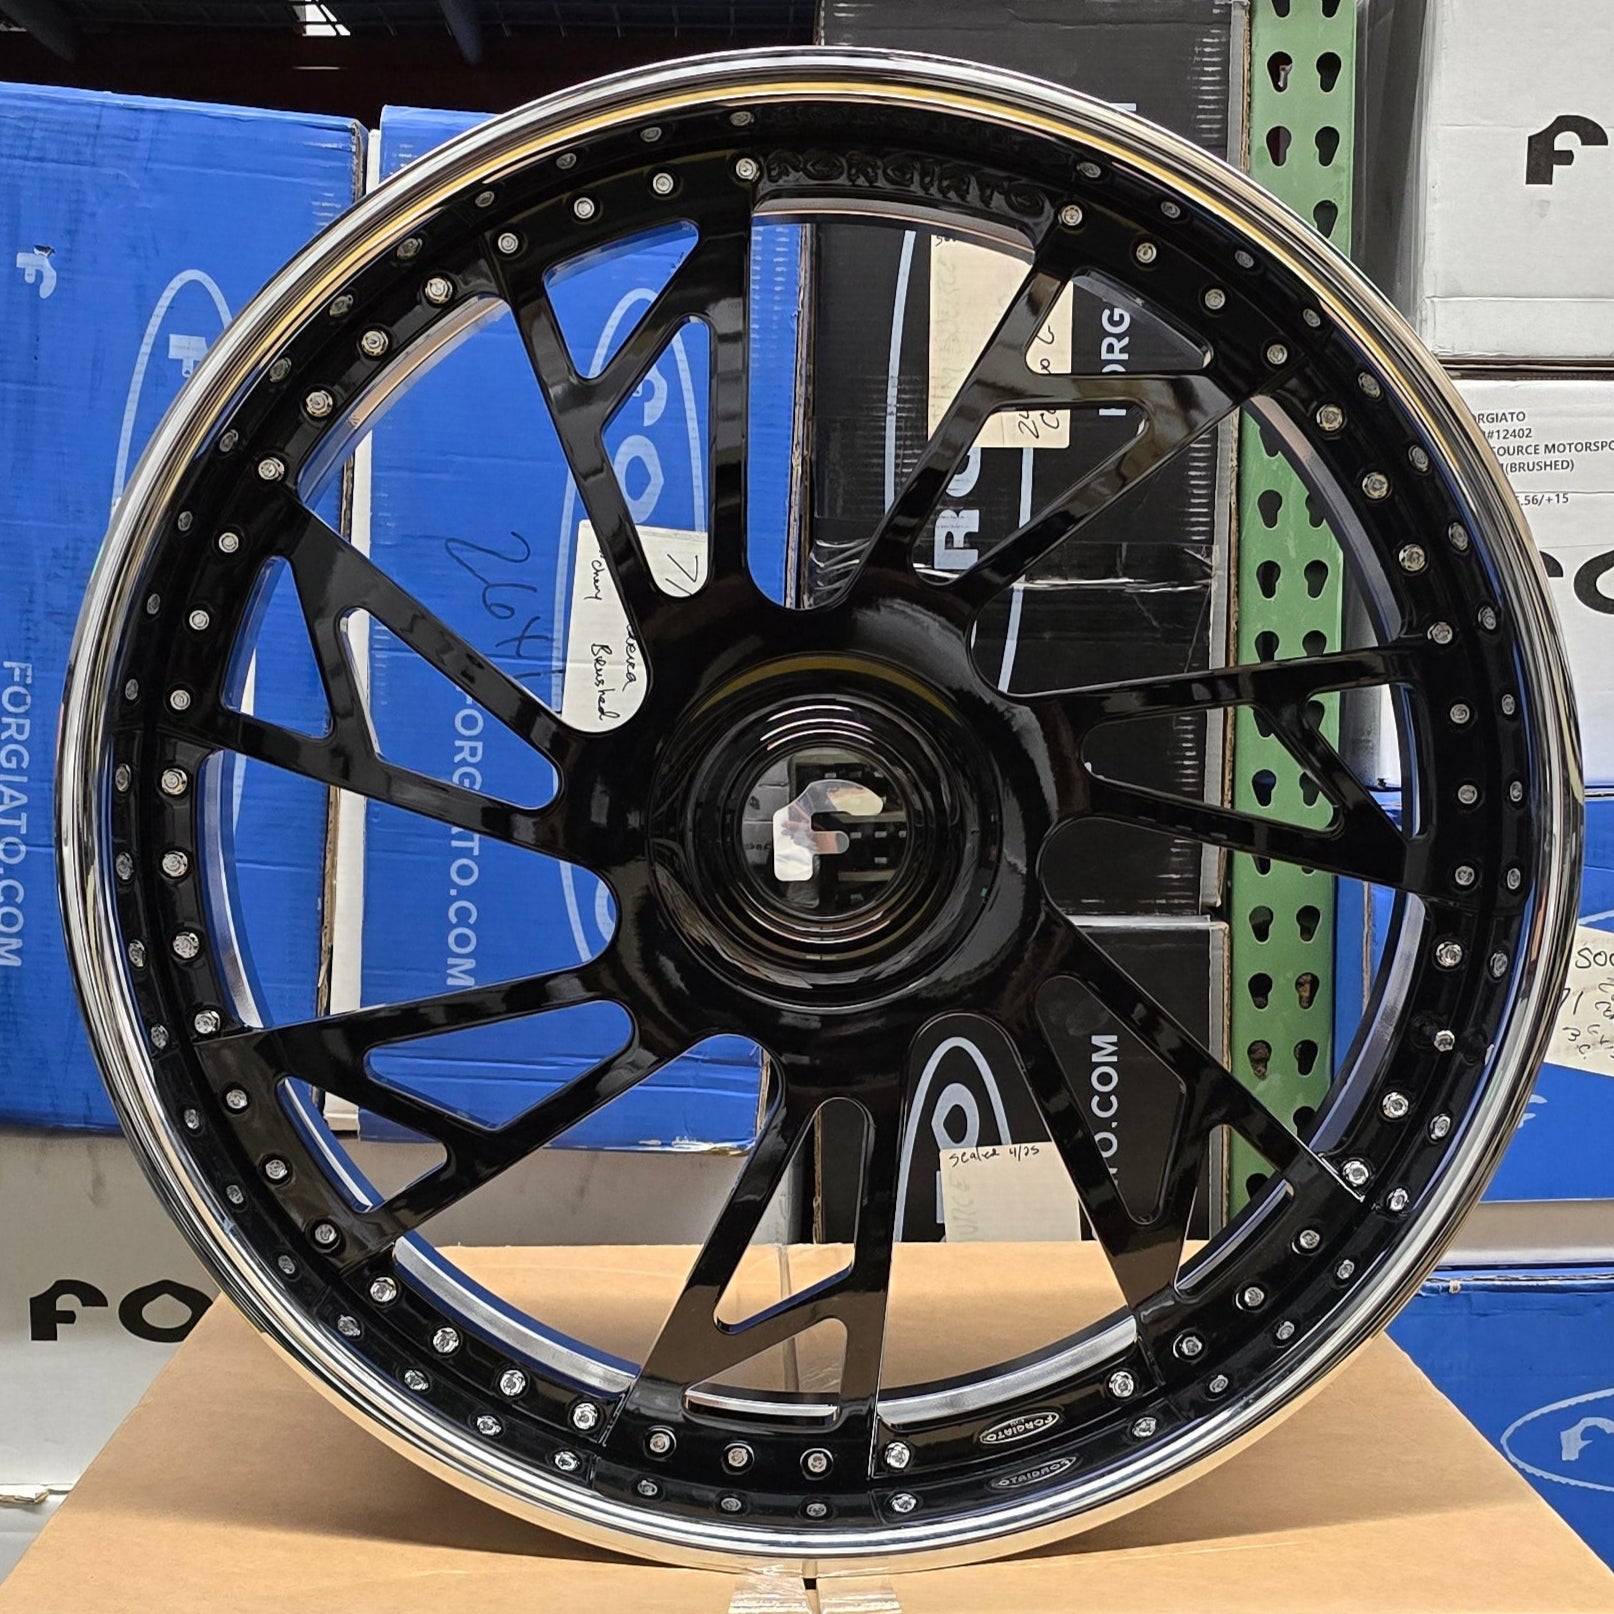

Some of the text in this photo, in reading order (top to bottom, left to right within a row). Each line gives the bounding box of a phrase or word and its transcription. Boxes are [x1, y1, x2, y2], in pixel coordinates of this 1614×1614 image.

[1481, 427, 1533, 441] #12402
[1500, 459, 1575, 475] (BRUSHED)
[983, 1414, 1054, 1441] FORGIATO
